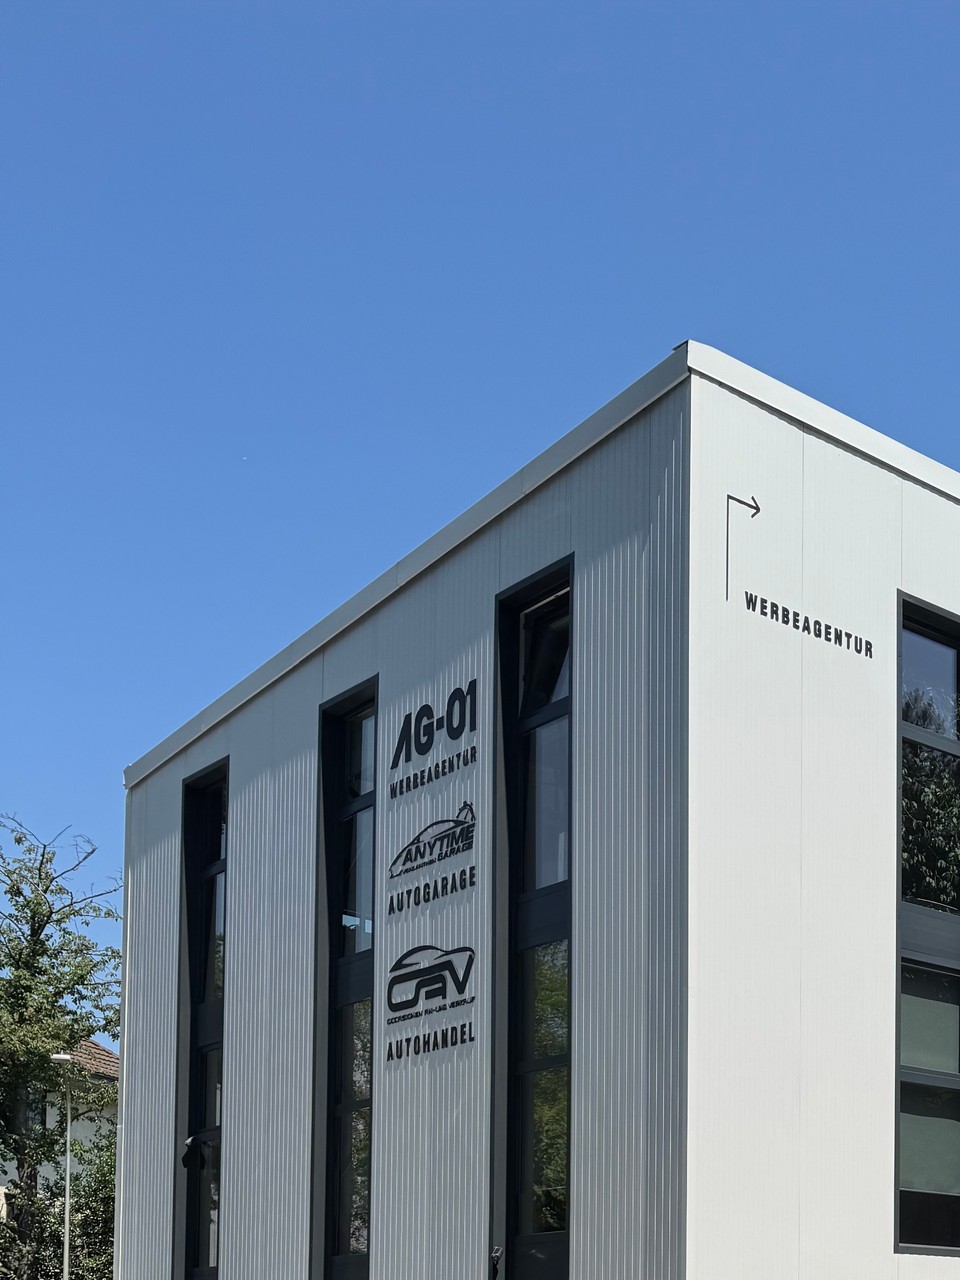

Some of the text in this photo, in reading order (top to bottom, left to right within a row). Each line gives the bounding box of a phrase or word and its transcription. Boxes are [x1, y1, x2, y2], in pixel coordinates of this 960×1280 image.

[744, 590, 873, 659] WERBEAGENTUR
[390, 678, 477, 770] AG-01
[389, 745, 478, 800] WERBEAGENTUR
[402, 822, 476, 867] ANYTIME
[437, 840, 474, 862] GARAGE
[388, 865, 476, 916] AUTOGARAGE
[386, 1021, 475, 1062] AUTOHANDEL
